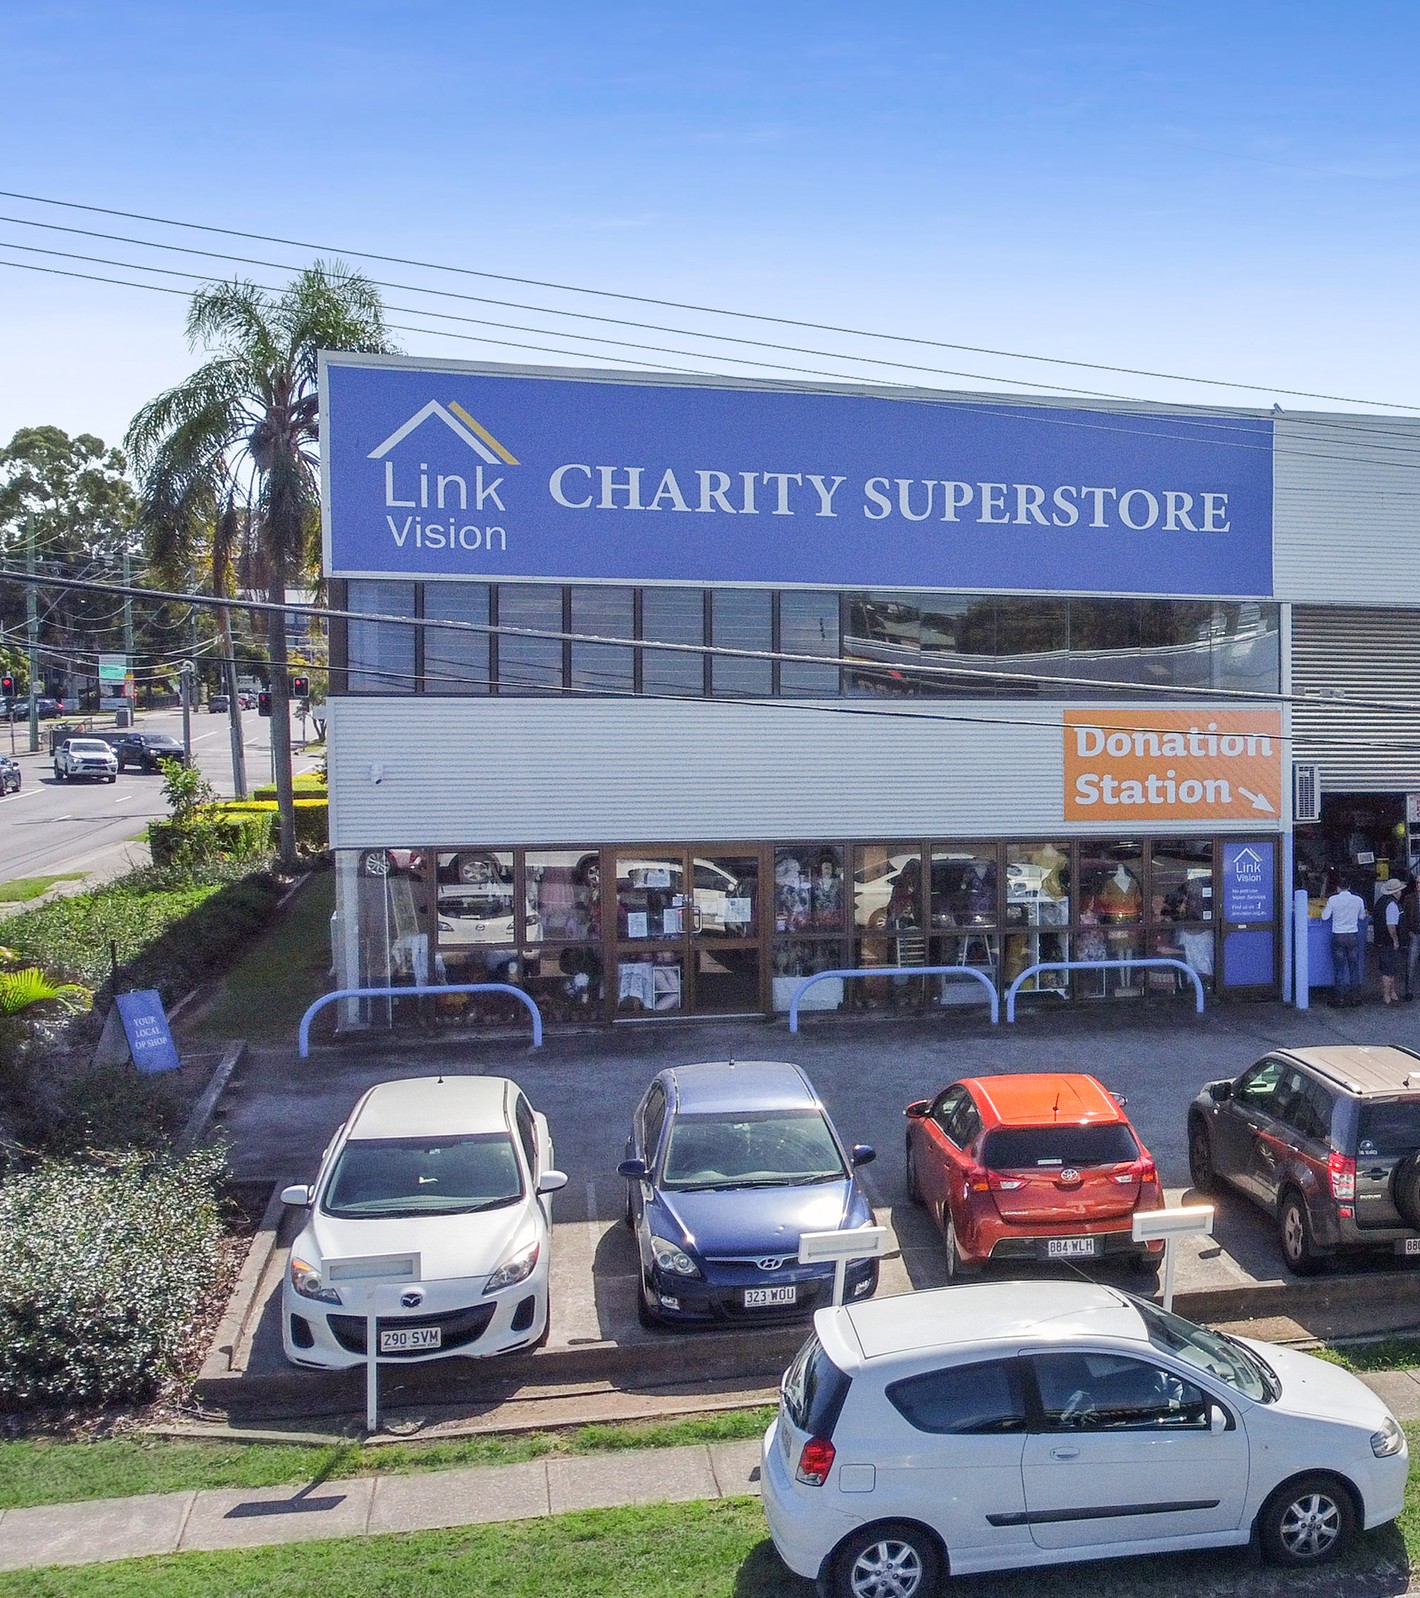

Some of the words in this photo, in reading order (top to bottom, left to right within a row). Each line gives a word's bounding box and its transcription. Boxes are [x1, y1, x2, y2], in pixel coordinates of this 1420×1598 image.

[384, 461, 505, 512] Link
[548, 463, 847, 517] CHARITY
[864, 477, 1231, 533] SUPERSTORE
[388, 514, 506, 552] Vision
[1074, 722, 1273, 757] Donation
[1075, 769, 1232, 805] Station
[1236, 861, 1261, 873] Link
[1236, 874, 1262, 882] Vision
[133, 1015, 157, 1026] YOUR
[135, 1027, 161, 1038] LOCAL
[135, 1041, 146, 1050] OP
[146, 1036, 168, 1048] SHOP
[746, 1290, 767, 1303] 323
[384, 1333, 407, 1346] 290
[411, 1330, 438, 1344] SVM
